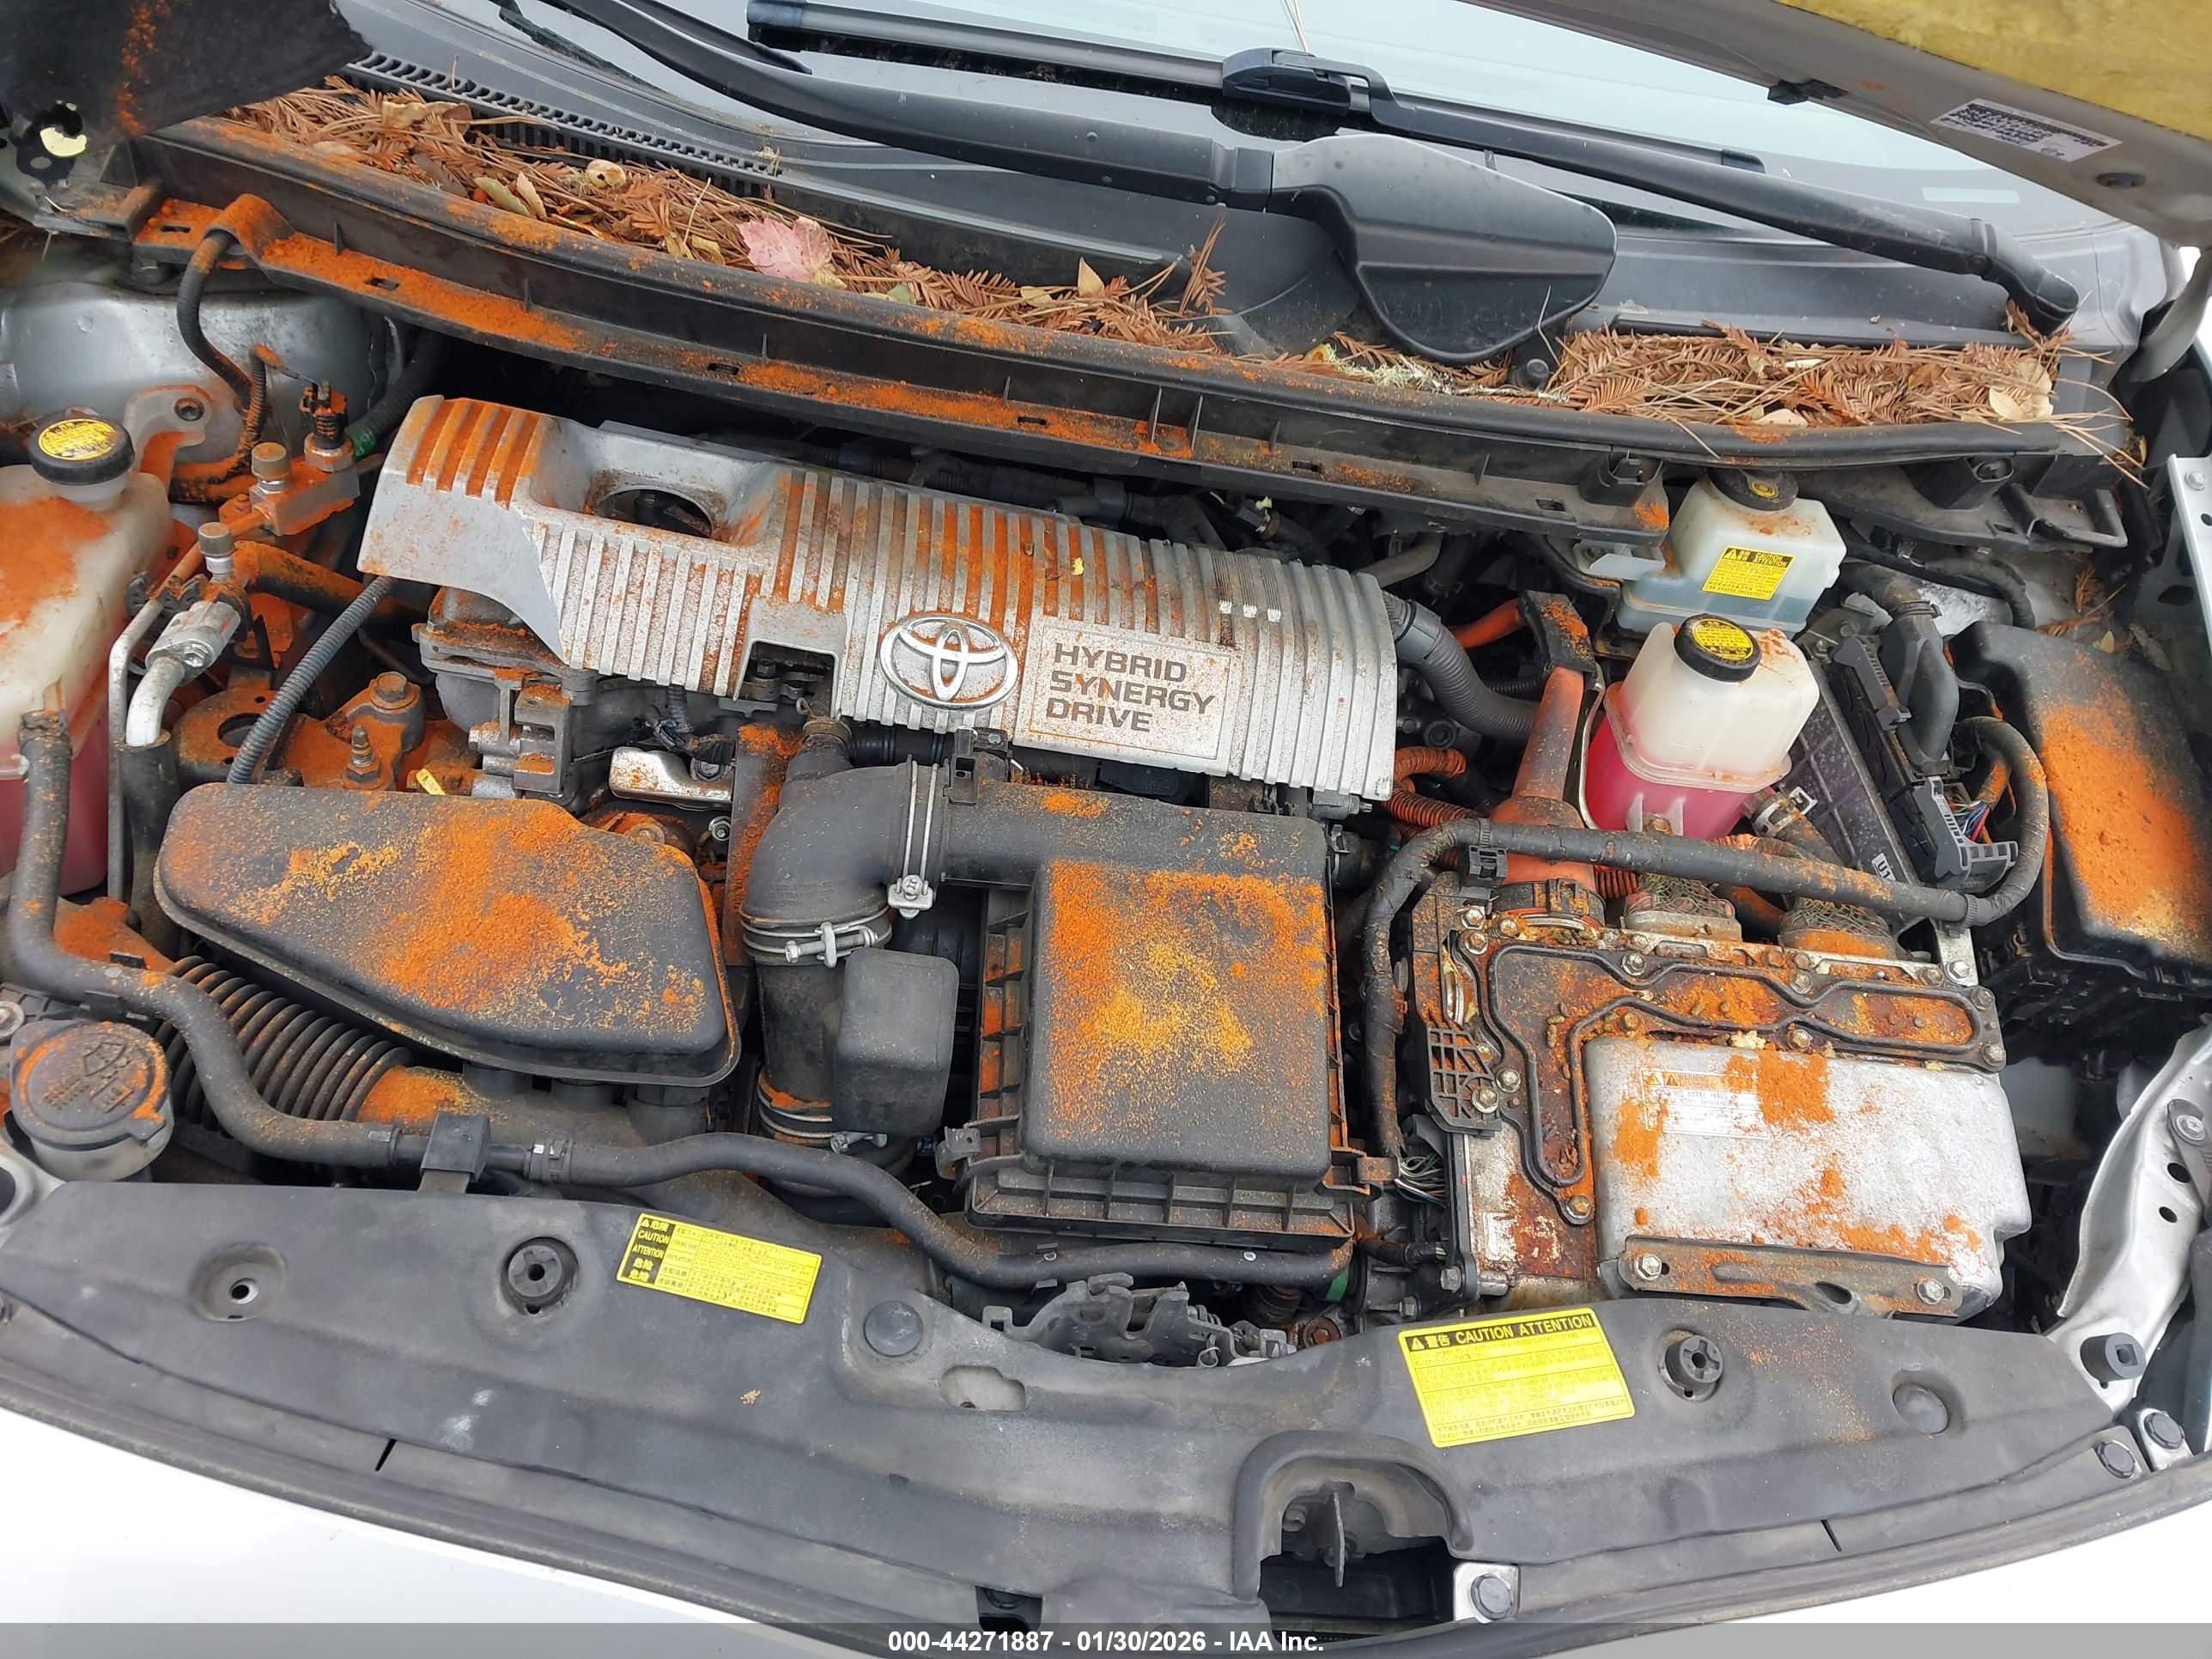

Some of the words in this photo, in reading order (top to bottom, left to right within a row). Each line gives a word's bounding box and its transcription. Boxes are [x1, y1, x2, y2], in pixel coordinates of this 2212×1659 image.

[1755, 552, 1784, 562] CAUTION
[1054, 642, 1187, 683] HYBRID
[1049, 670, 1216, 714] SYNERGY
[1046, 697, 1152, 732] DRIVE
[632, 1244, 665, 1259] ATTENTION
[637, 1230, 670, 1244] CAUTION
[1425, 1332, 1450, 1349] 警告
[1455, 1325, 1514, 1346] CAUTION
[1519, 1315, 1593, 1337] ATTENTION
